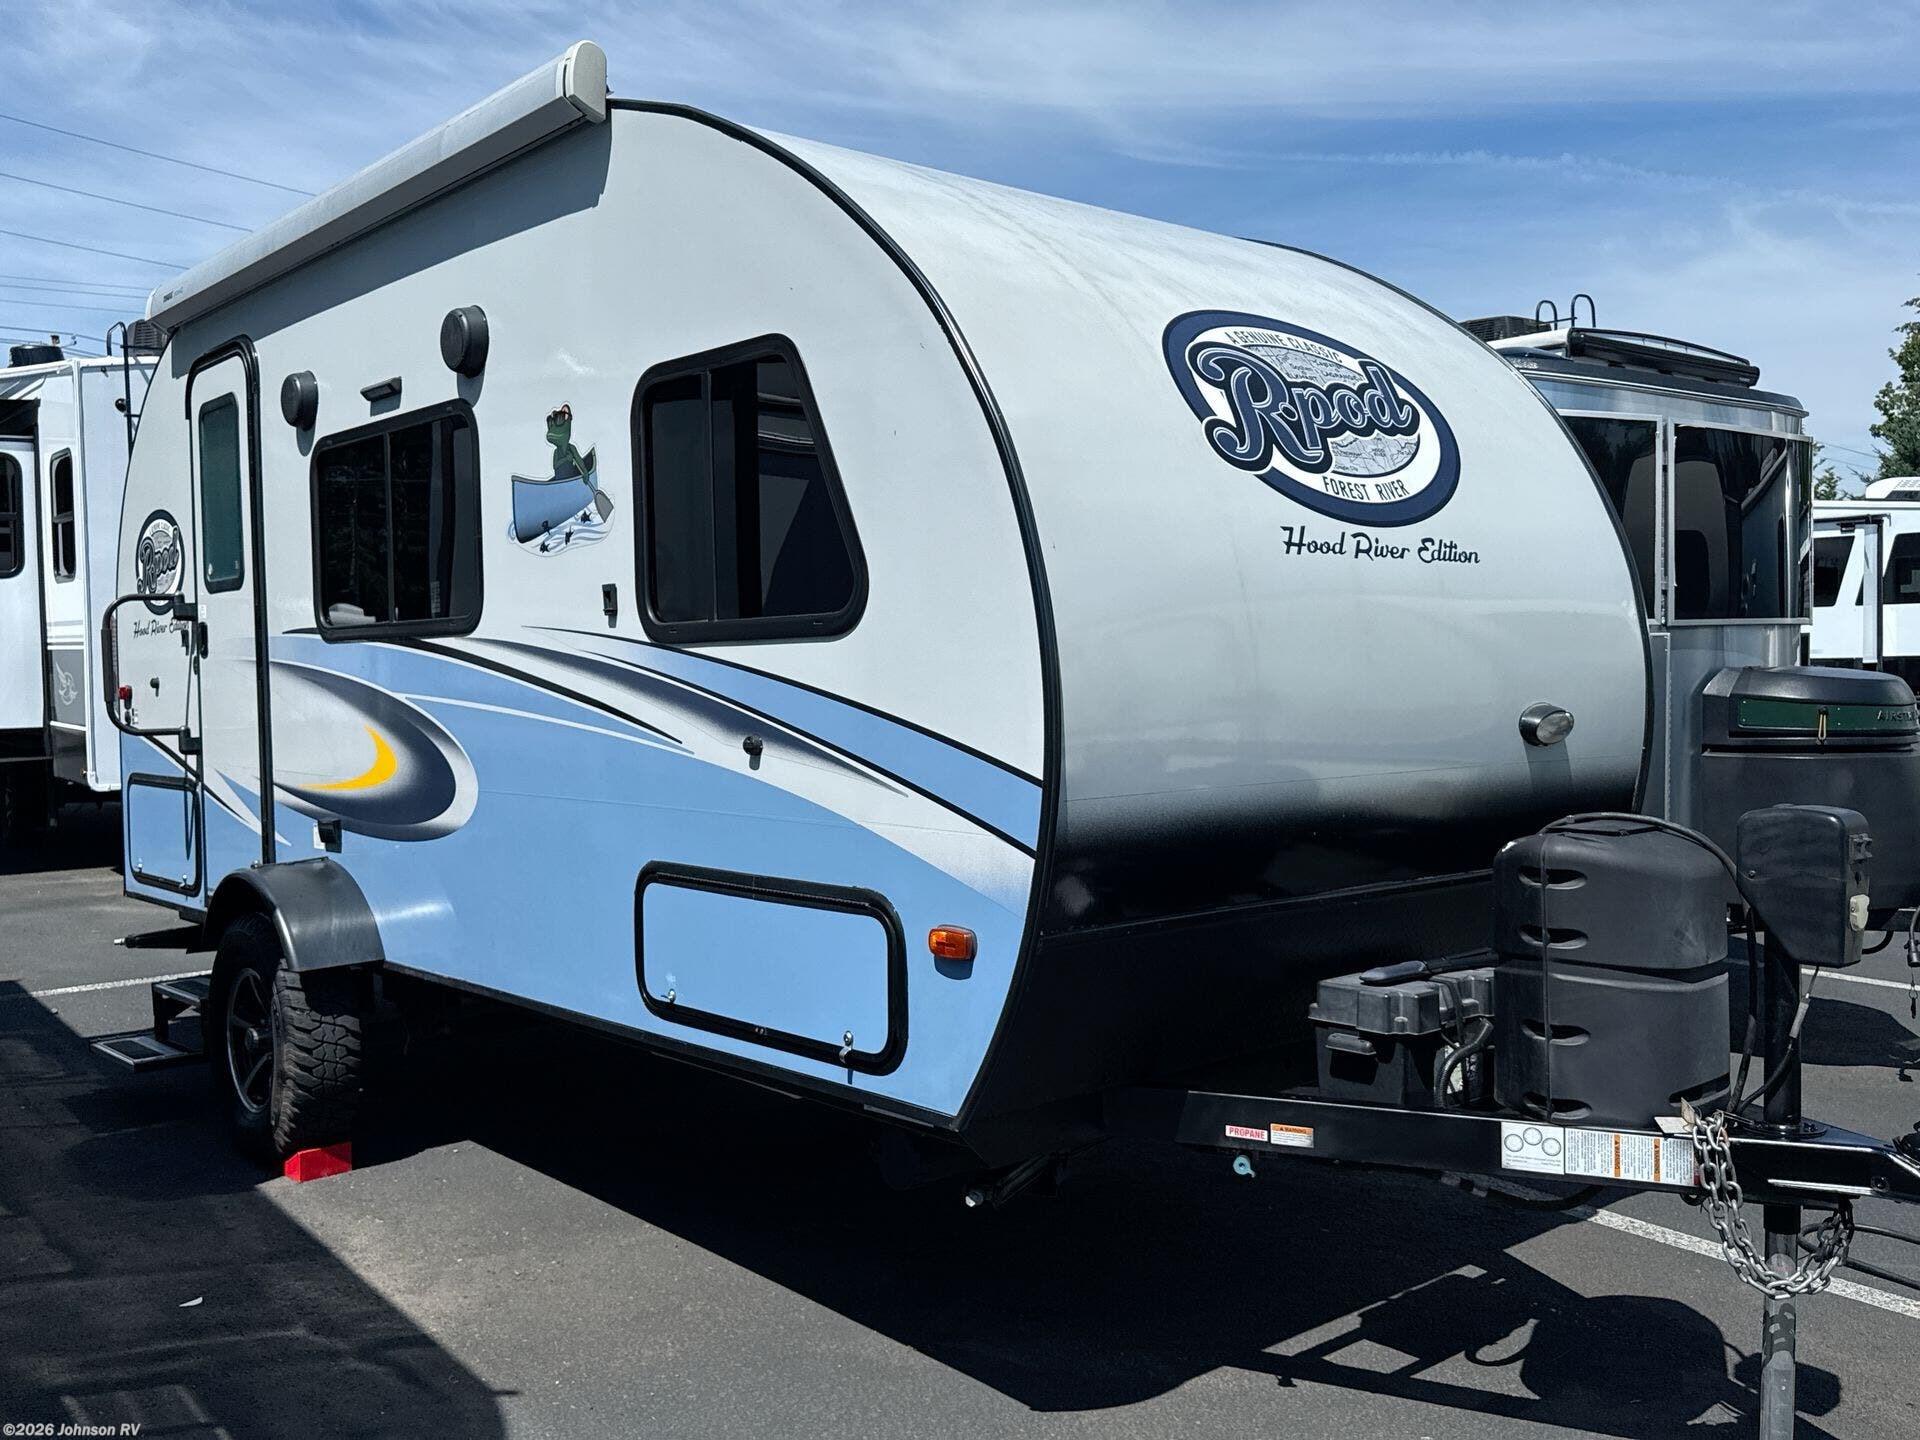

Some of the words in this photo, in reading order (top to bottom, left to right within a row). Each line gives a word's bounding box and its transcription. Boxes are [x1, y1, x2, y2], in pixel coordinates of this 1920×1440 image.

[1224, 331, 1240, 345] A
[1233, 330, 1288, 347] GENUINE
[1287, 337, 1343, 363] CLASSIC
[1322, 476, 1370, 501] FOREST
[1374, 479, 1410, 501] RIVER
[1280, 525, 1346, 555] Hood
[1350, 532, 1410, 561] River
[1417, 537, 1480, 564] Edition
[1229, 1126, 1265, 1139] PROPANE
